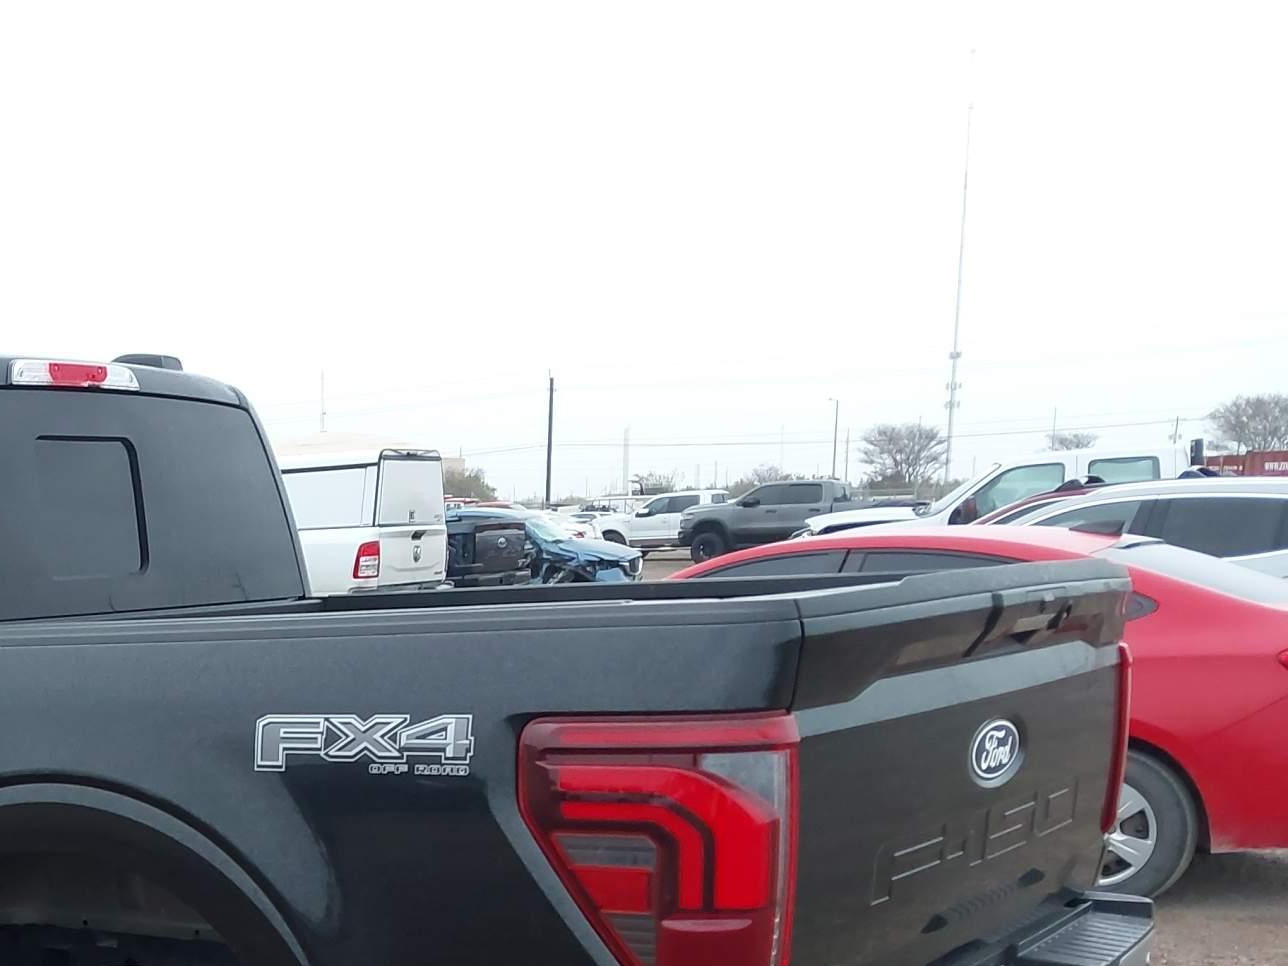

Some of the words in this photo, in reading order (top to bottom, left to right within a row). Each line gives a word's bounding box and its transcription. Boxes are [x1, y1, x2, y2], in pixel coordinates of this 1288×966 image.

[254, 714, 474, 771] FX4
[980, 729, 1013, 770] Ford
[368, 763, 409, 775] OFF
[414, 764, 470, 776] ROAD
[870, 776, 1079, 907] F-150
